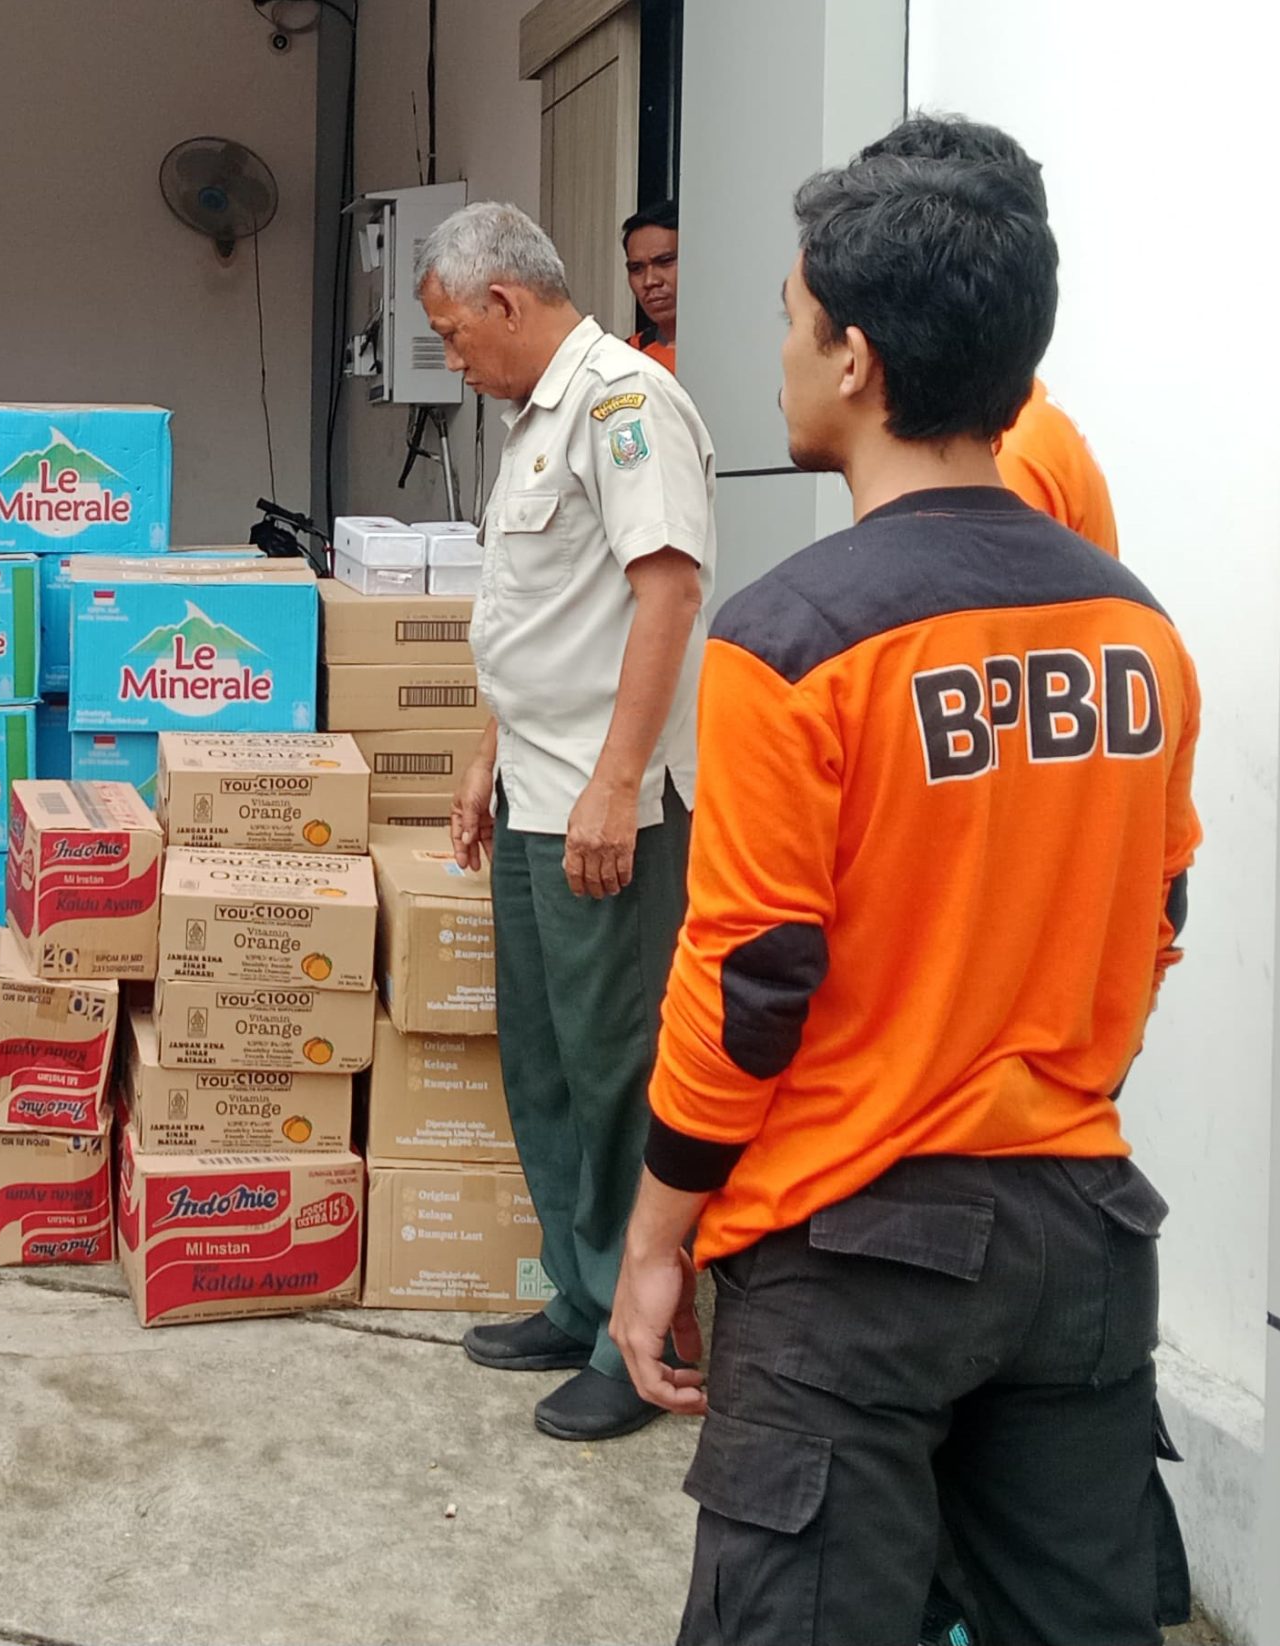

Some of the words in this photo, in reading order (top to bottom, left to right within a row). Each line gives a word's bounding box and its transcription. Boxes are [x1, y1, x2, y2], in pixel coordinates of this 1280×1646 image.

[40, 460, 77, 494] Le
[175, 636, 216, 670] Le
[120, 668, 271, 701] Minerale
[912, 643, 1165, 786] BPBD
[251, 798, 291, 806] Vitamin
[238, 804, 302, 822] Orange
[247, 927, 289, 938] Vitamin
[233, 933, 301, 954] Orange
[249, 1014, 290, 1022] Vitamin
[235, 1019, 302, 1039] Orange
[228, 1094, 270, 1102] Vitamin
[215, 1100, 282, 1119] Orange
[418, 1190, 460, 1202] Original
[206, 1241, 250, 1255] Instan
[192, 1273, 256, 1292] Kaldu
[261, 1270, 320, 1290] Ayam
